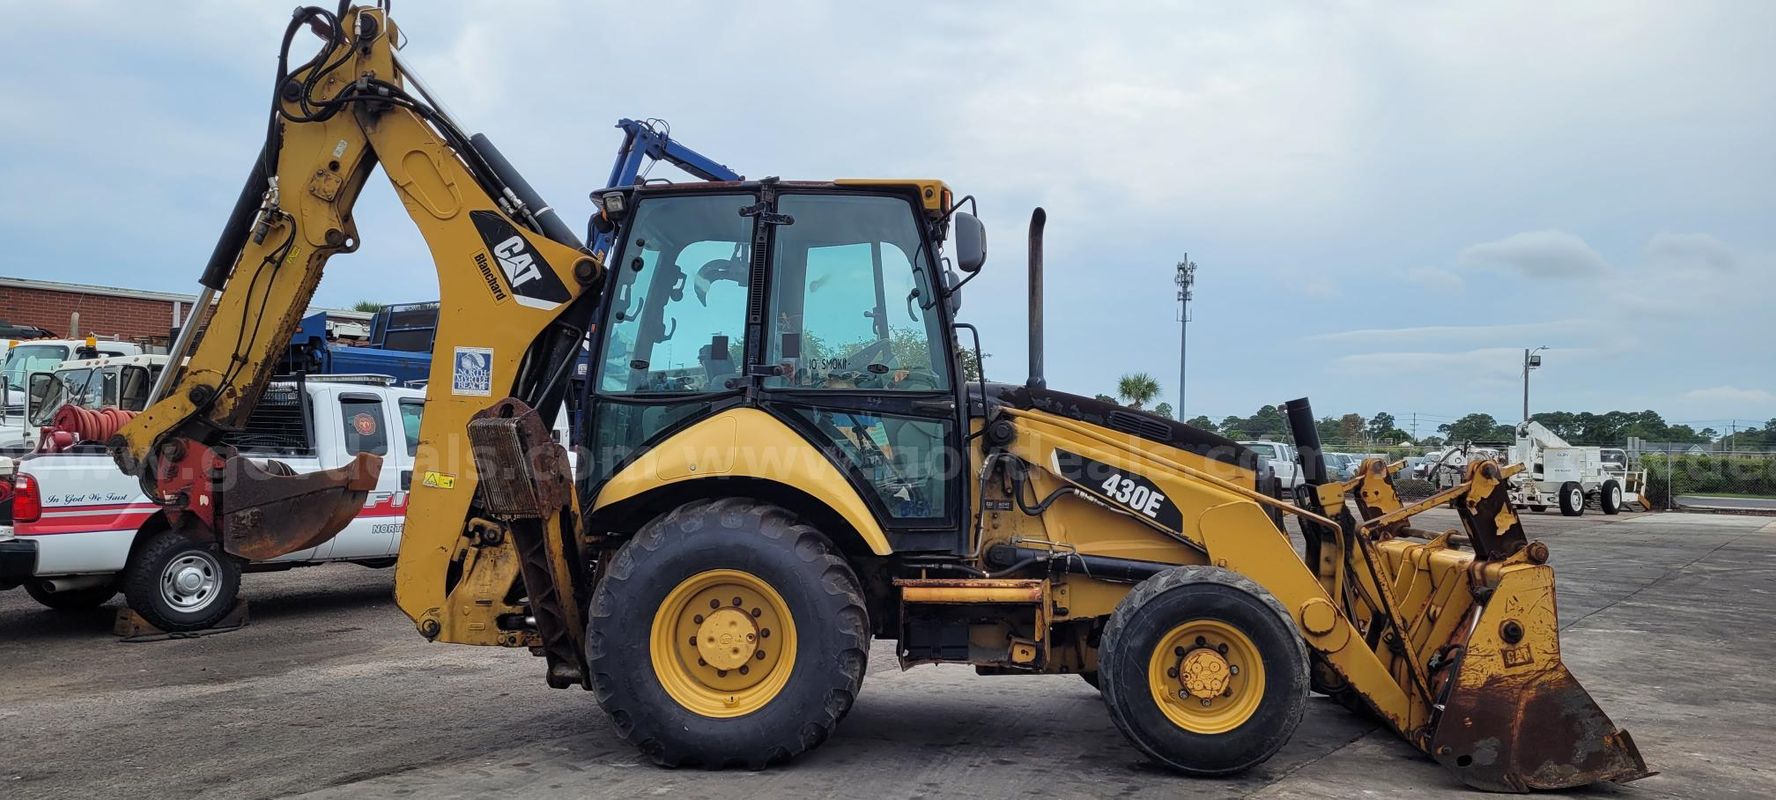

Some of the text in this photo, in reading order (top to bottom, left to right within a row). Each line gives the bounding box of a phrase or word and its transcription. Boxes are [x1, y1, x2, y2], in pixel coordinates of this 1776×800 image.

[494, 236, 542, 288] CAT
[474, 253, 507, 301] Blanchard
[455, 374, 489, 384] MYRTLE
[456, 368, 488, 377] NORTH
[457, 382, 488, 391] BEACH
[46, 494, 59, 503] In
[63, 494, 85, 505] God
[88, 493, 101, 502] We
[363, 490, 409, 508] FI
[1101, 474, 1165, 518] 430E
[371, 523, 405, 534] NORT
[1506, 648, 1530, 665] CAT
